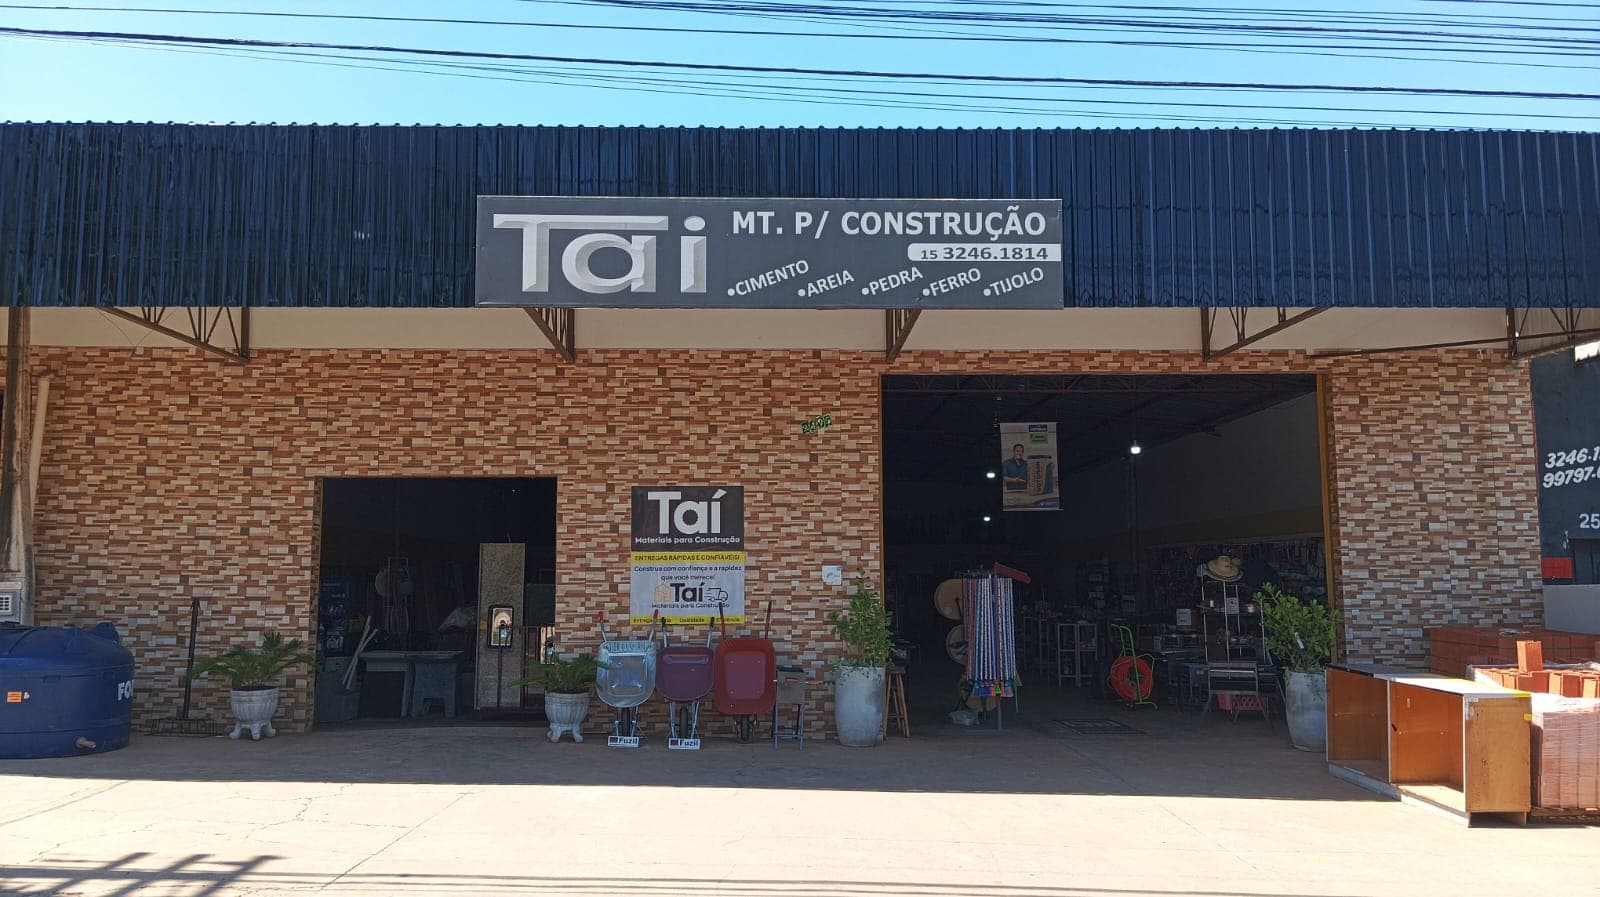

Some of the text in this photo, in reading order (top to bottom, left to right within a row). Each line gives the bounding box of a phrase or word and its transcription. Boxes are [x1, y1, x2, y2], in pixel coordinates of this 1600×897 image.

[732, 205, 1046, 241] MT. P/ CONSTRUÇÃO
[493, 213, 707, 294] Tai
[921, 246, 1049, 260] 15 3246.1814
[735, 259, 1045, 298] CIMENTO AREIA PEDRA FERRO TIJOLO
[1544, 446, 1600, 469] 3246.1
[647, 488, 728, 535] Taí
[635, 535, 740, 545] Materiais para Construção
[678, 565, 708, 573] confiança
[719, 565, 742, 573] rapidez
[670, 582, 705, 603] Taí
[618, 736, 638, 745] Fuzil
[679, 739, 699, 747] Fuzil
